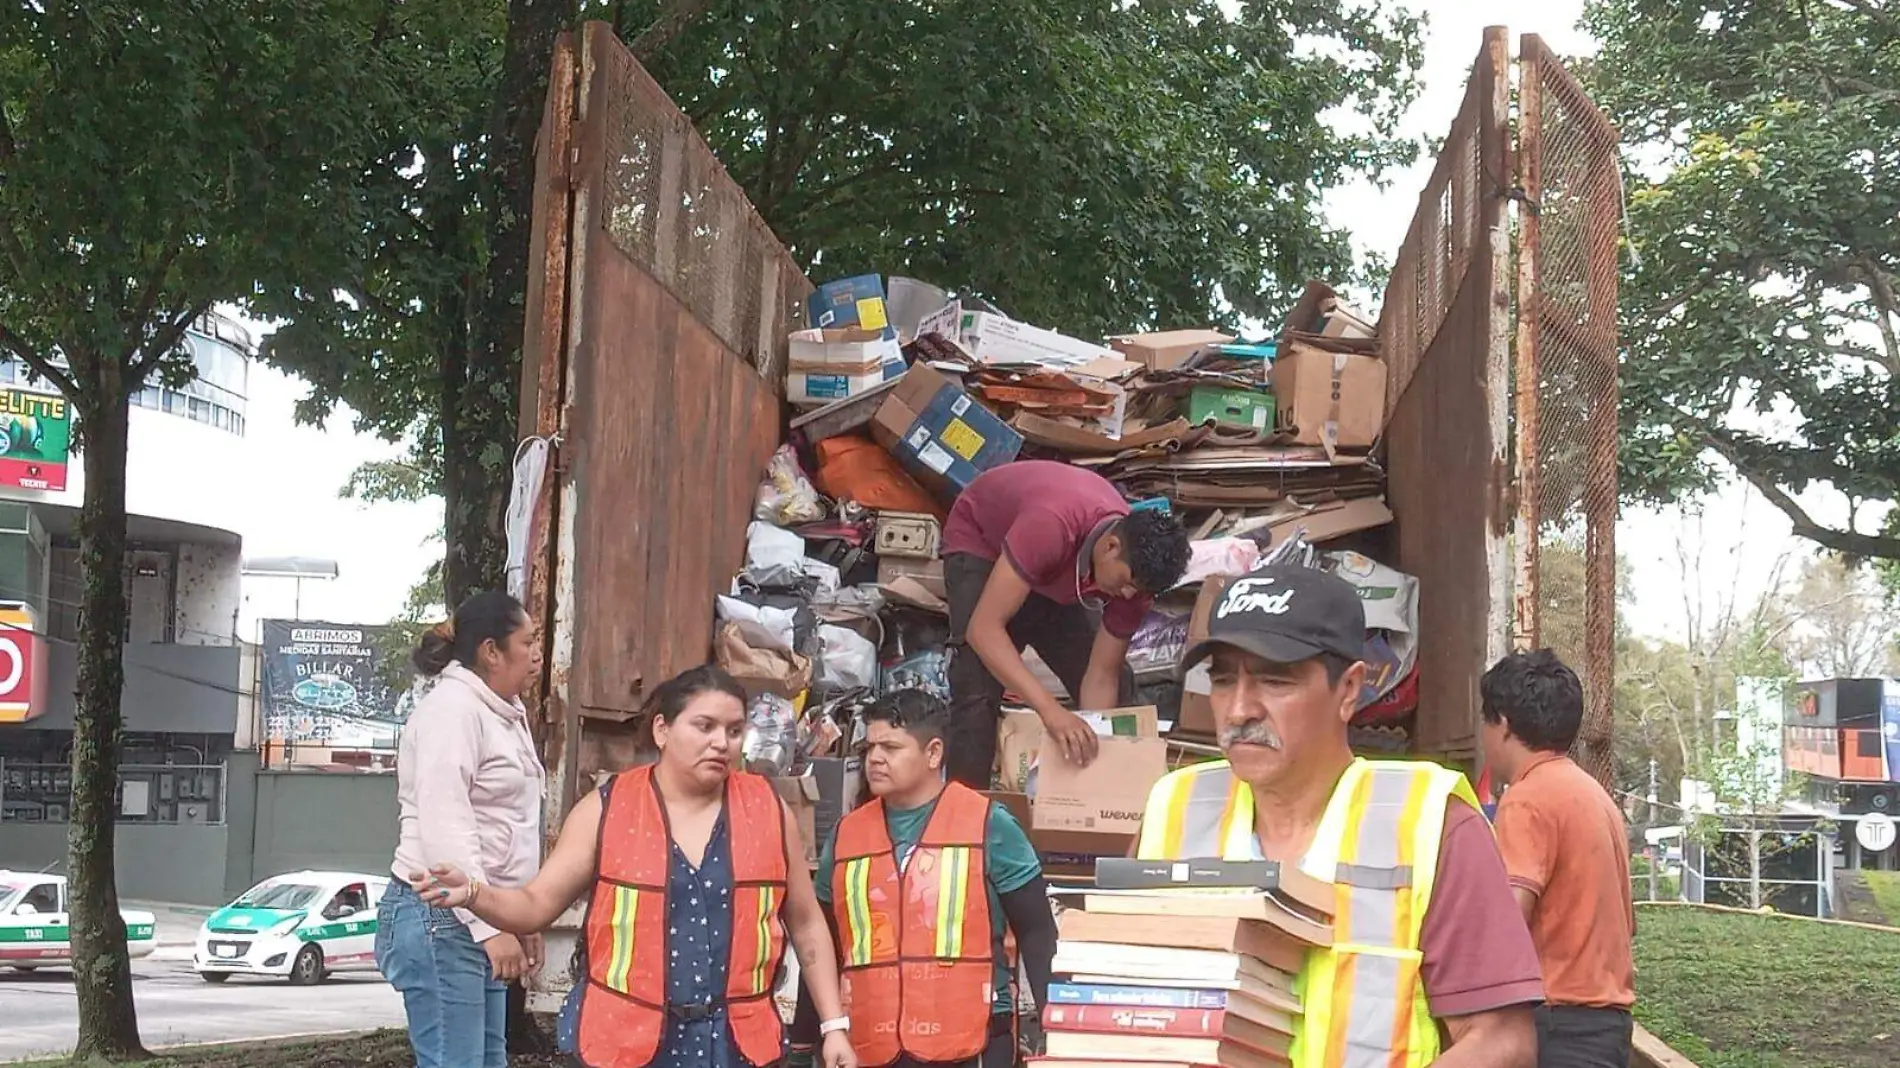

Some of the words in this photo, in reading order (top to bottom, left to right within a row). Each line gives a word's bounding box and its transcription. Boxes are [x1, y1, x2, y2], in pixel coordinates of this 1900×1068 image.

[1216, 577, 1294, 619] Ford
[294, 630, 359, 642] ABRIMOS
[295, 661, 354, 678] BILLAR
